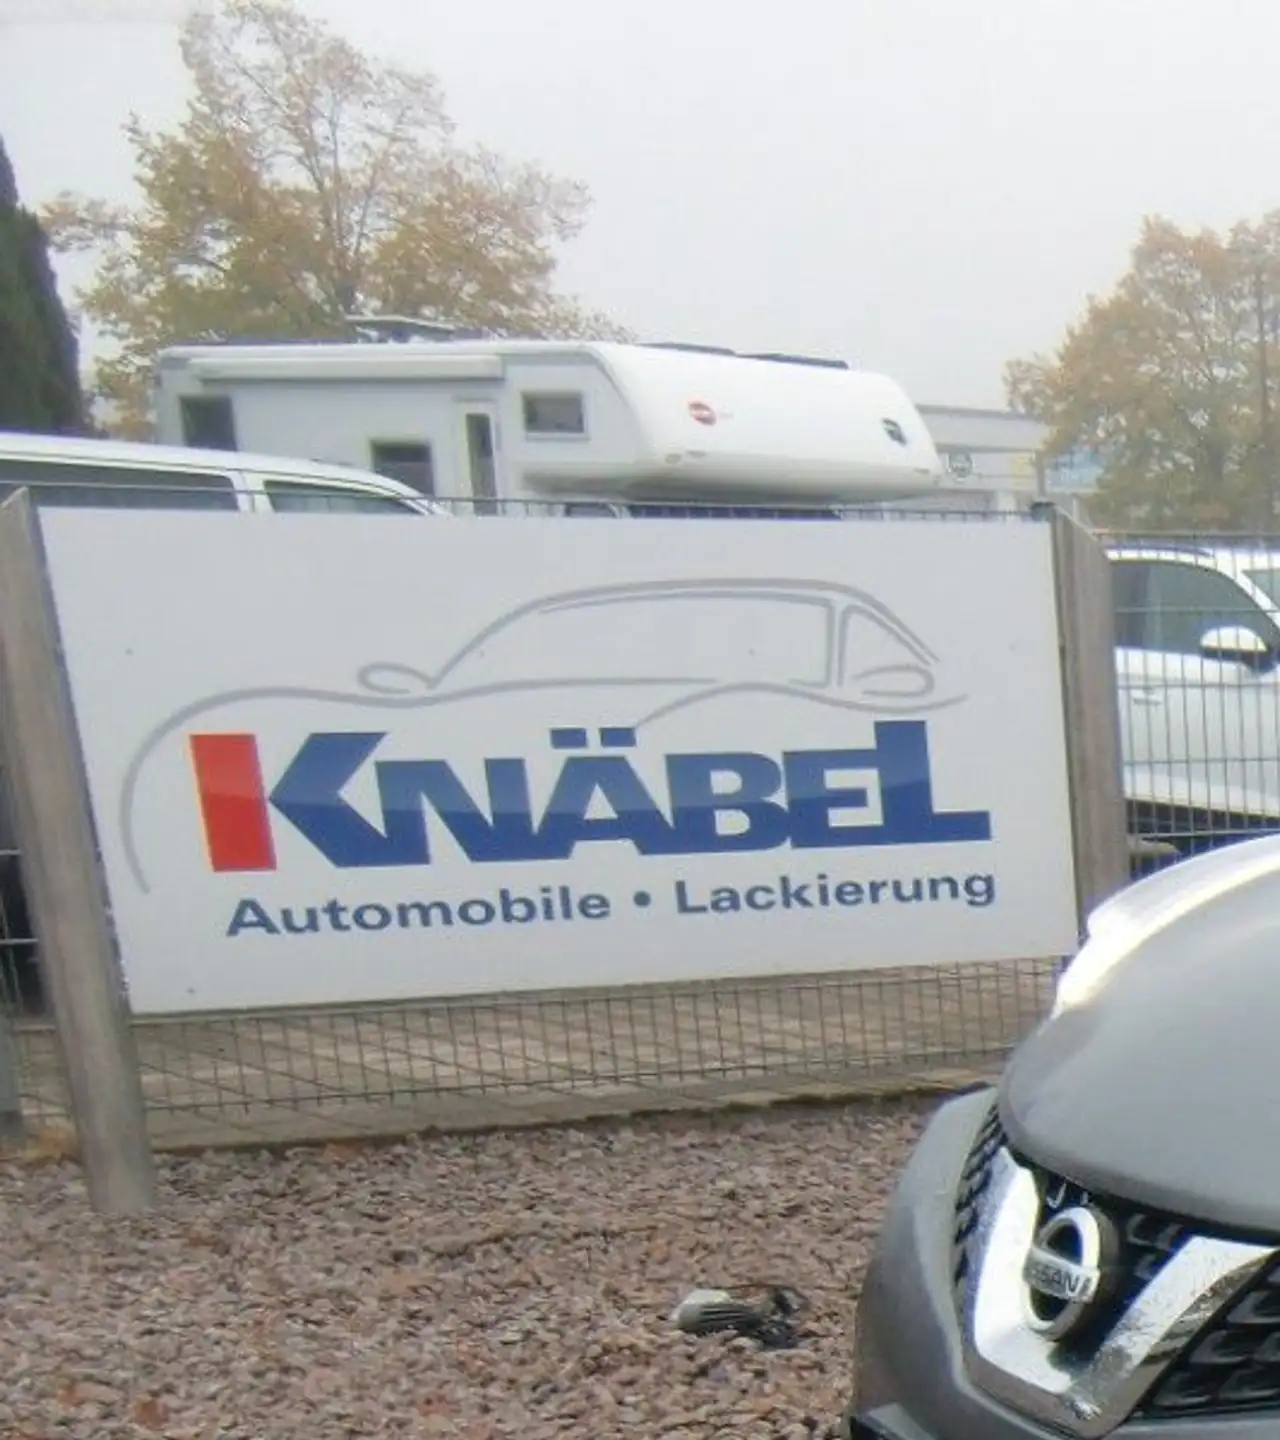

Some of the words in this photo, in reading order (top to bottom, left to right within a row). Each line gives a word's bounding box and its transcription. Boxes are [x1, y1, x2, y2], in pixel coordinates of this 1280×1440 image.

[189, 720, 991, 872] KNÄBEL
[226, 886, 611, 937] Automobile
[675, 873, 995, 915] Lackierung
